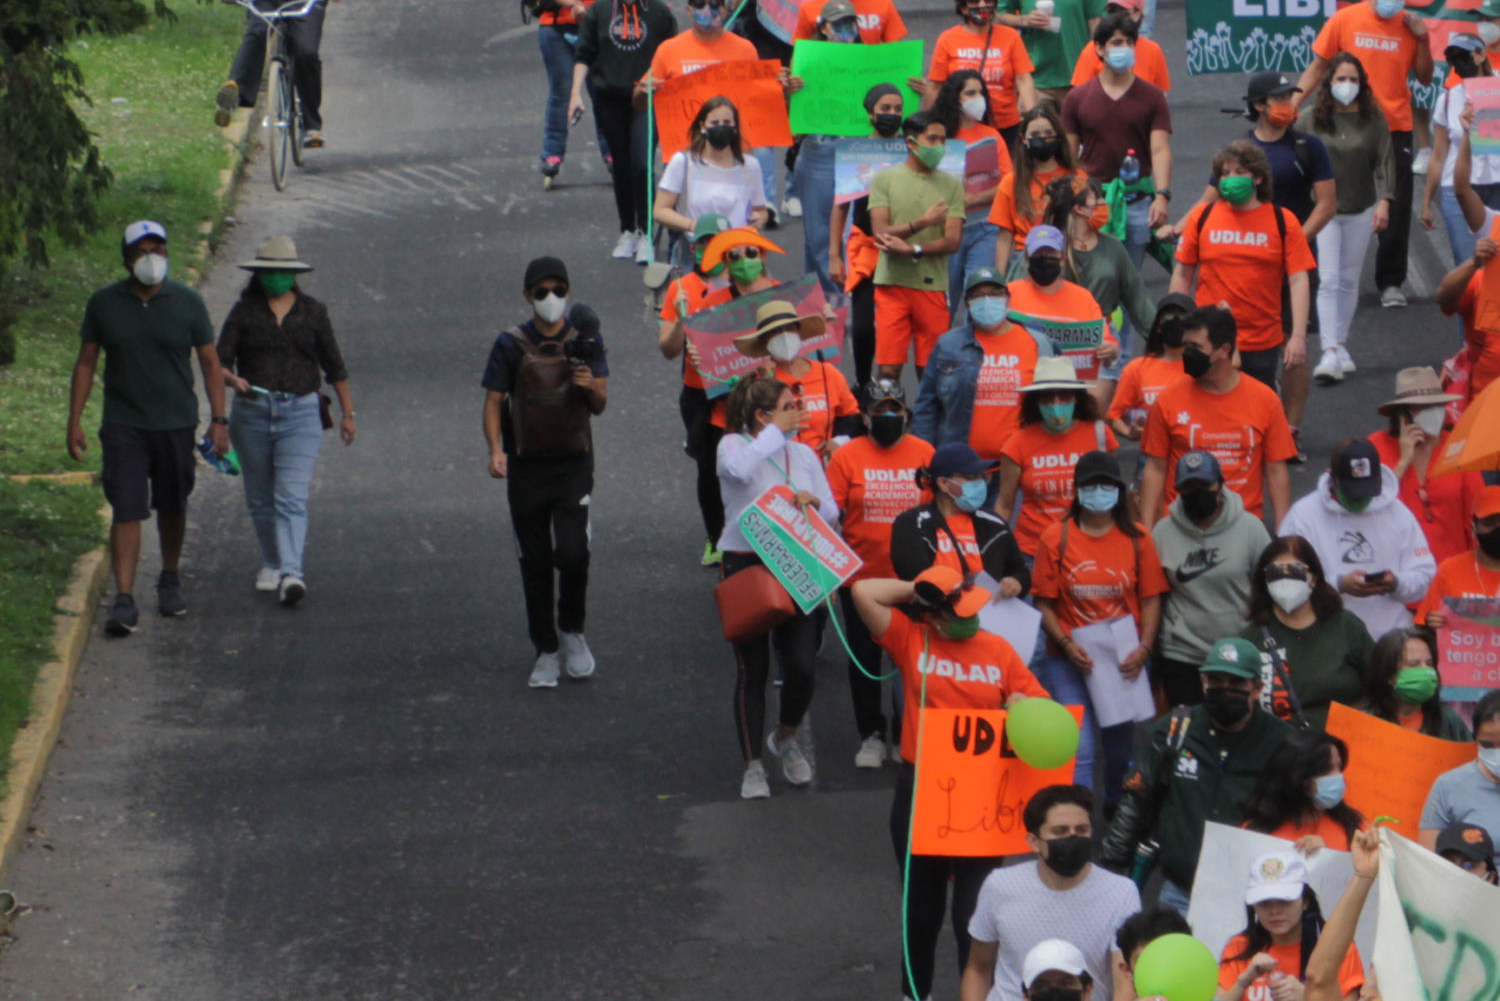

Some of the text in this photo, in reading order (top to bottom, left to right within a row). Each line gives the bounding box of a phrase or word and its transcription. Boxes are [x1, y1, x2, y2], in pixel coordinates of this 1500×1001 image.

[1354, 36, 1399, 52] UDLAP
[1208, 229, 1269, 246] UDLAP
[864, 468, 917, 482] UDLAP
[743, 510, 823, 600] #FUERAARMAS
[1184, 547, 1220, 567] NIKE
[1450, 630, 1484, 650] Soy
[1446, 649, 1497, 668] tengo
[916, 651, 1003, 686] UDLAP
[1472, 669, 1482, 682] a
